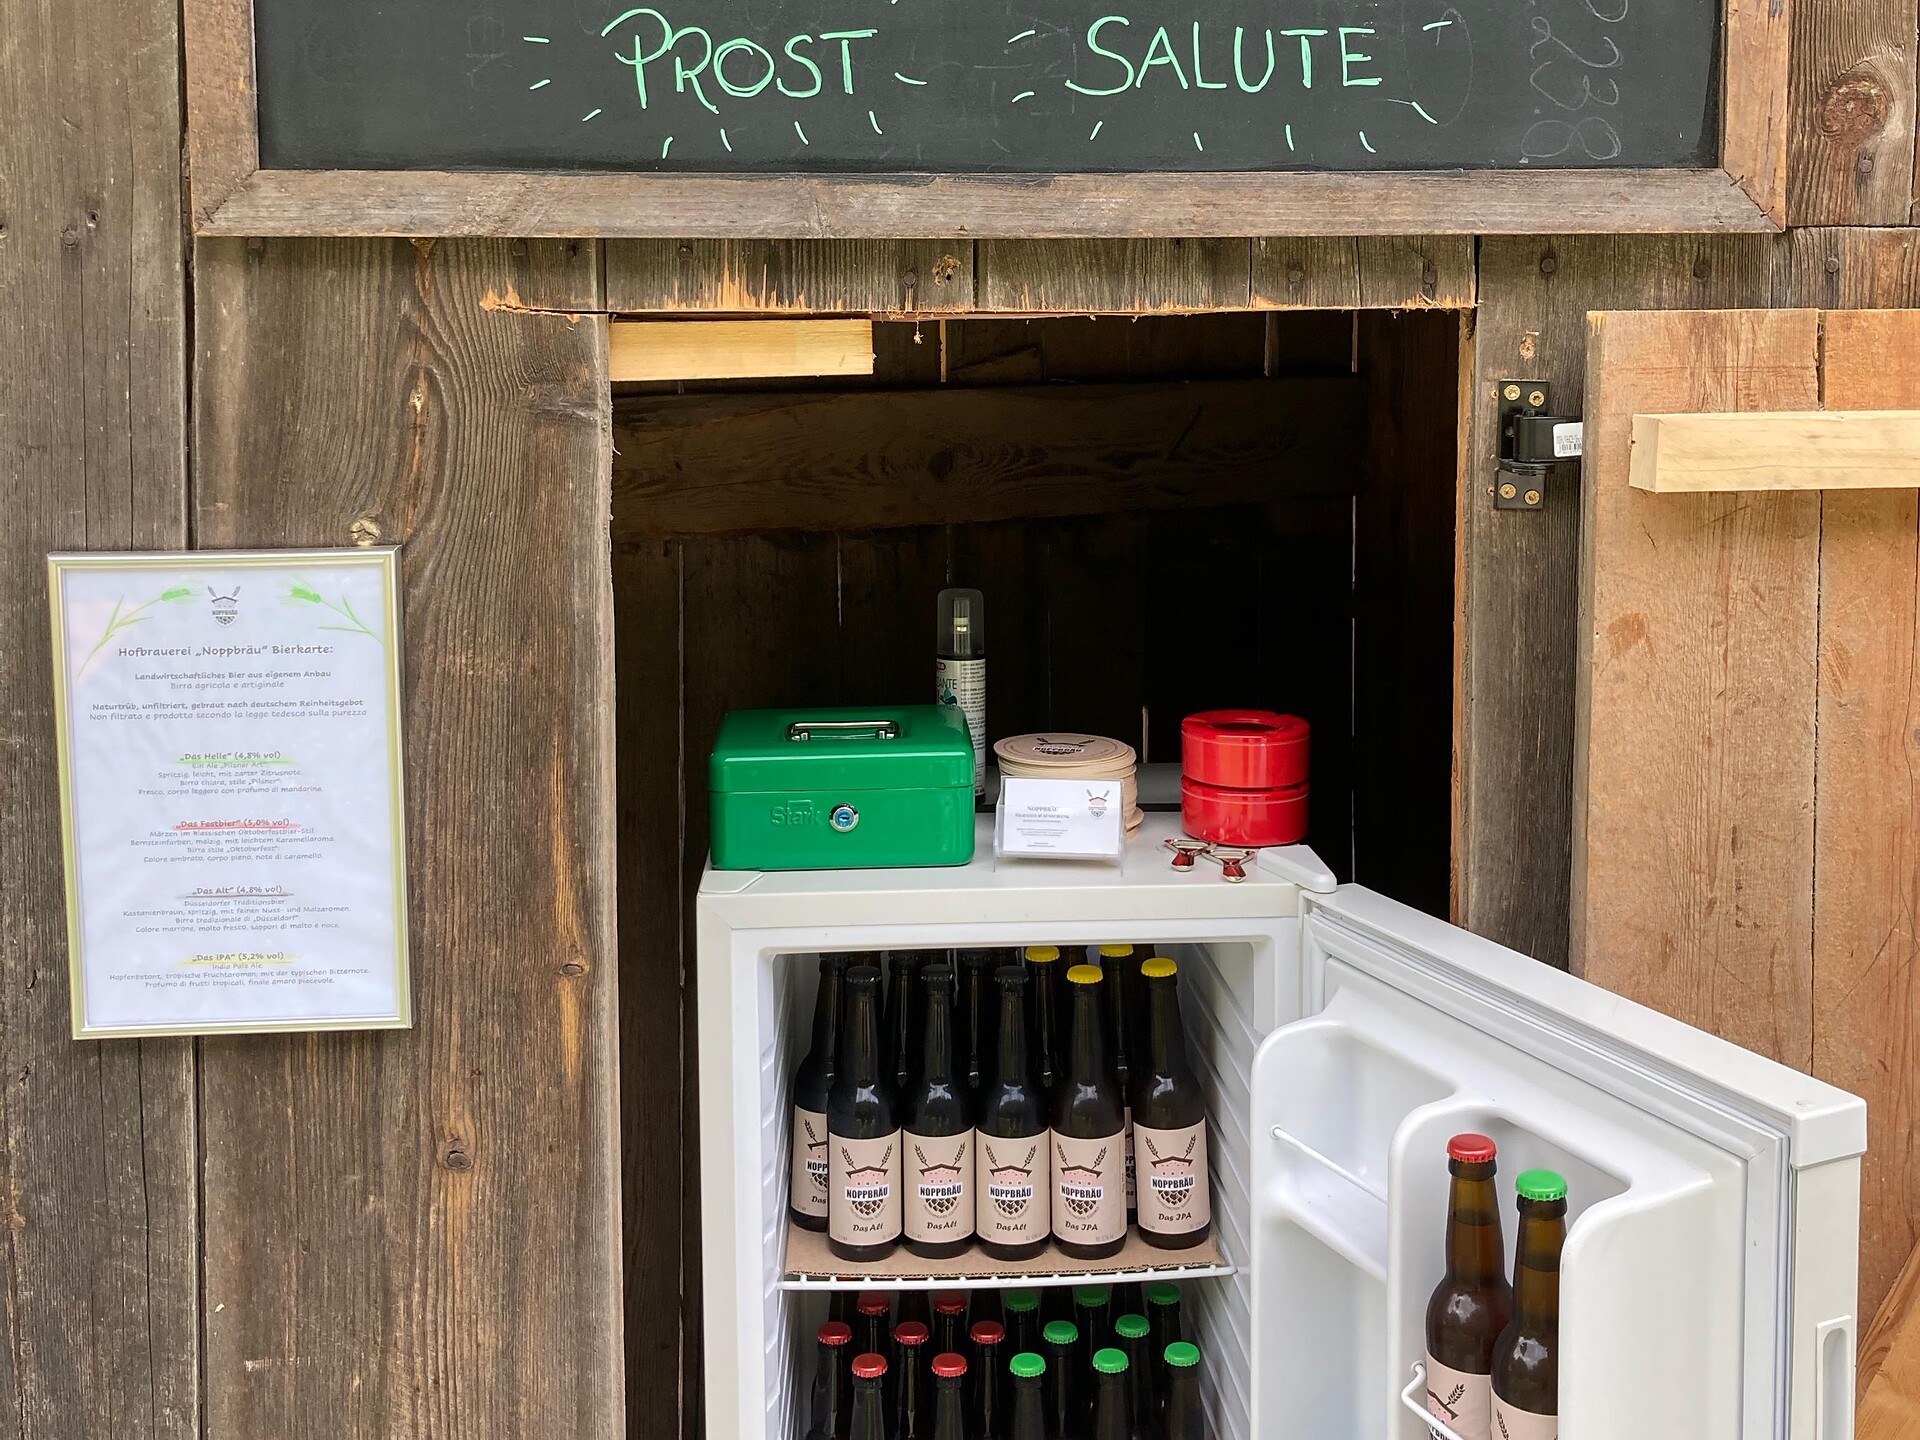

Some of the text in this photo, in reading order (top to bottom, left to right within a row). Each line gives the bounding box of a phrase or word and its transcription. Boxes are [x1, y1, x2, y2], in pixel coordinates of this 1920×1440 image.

[601, 8, 878, 114] PROST
[1066, 16, 1382, 96] SALUTE
[118, 647, 191, 657] Hofbrauerei
[272, 645, 334, 655] Bierkarte:
[135, 672, 225, 680] Landwirtschaftliches
[228, 671, 245, 679] Bier
[265, 672, 301, 680] eigenem
[303, 670, 331, 678] Anbau
[195, 682, 230, 691] agricola
[92, 699, 364, 711] Naturtrüb, unfiltriert, gebraut nach deutschem Reinheitsgebot
[110, 712, 143, 720] filtrata
[153, 712, 193, 721] prodotta
[195, 711, 232, 719] secondo
[245, 711, 269, 719] legge
[308, 709, 330, 717] sulla
[332, 710, 367, 718] purezza
[234, 752, 261, 760] (4,8%
[263, 751, 281, 759] vol)
[191, 788, 219, 796] leggero
[243, 819, 270, 828] (5,0%
[236, 885, 263, 894] (4,8%
[265, 885, 283, 893] vol)
[238, 952, 264, 961] (5,2%
[266, 952, 284, 960] vol)
[165, 972, 201, 980] tropische
[290, 969, 327, 977] typischen
[188, 980, 210, 988] frutti
[807, 1161, 828, 1172] NOPP
[1152, 1176, 1194, 1189] NOPPBRÄU
[847, 1186, 888, 1199] NOPPBRÄU
[920, 1183, 962, 1197] NOPPBRÄU
[990, 1186, 1032, 1199] NOPPBRÄU
[1061, 1185, 1102, 1199] NOPPBRÄU
[812, 1195, 827, 1204] Das
[1158, 1213, 1174, 1221] Das
[853, 1222, 884, 1232] Das Alt
[927, 1220, 958, 1230] Das Alt
[996, 1222, 1027, 1232] Das Alt
[1065, 1220, 1079, 1231] Das
